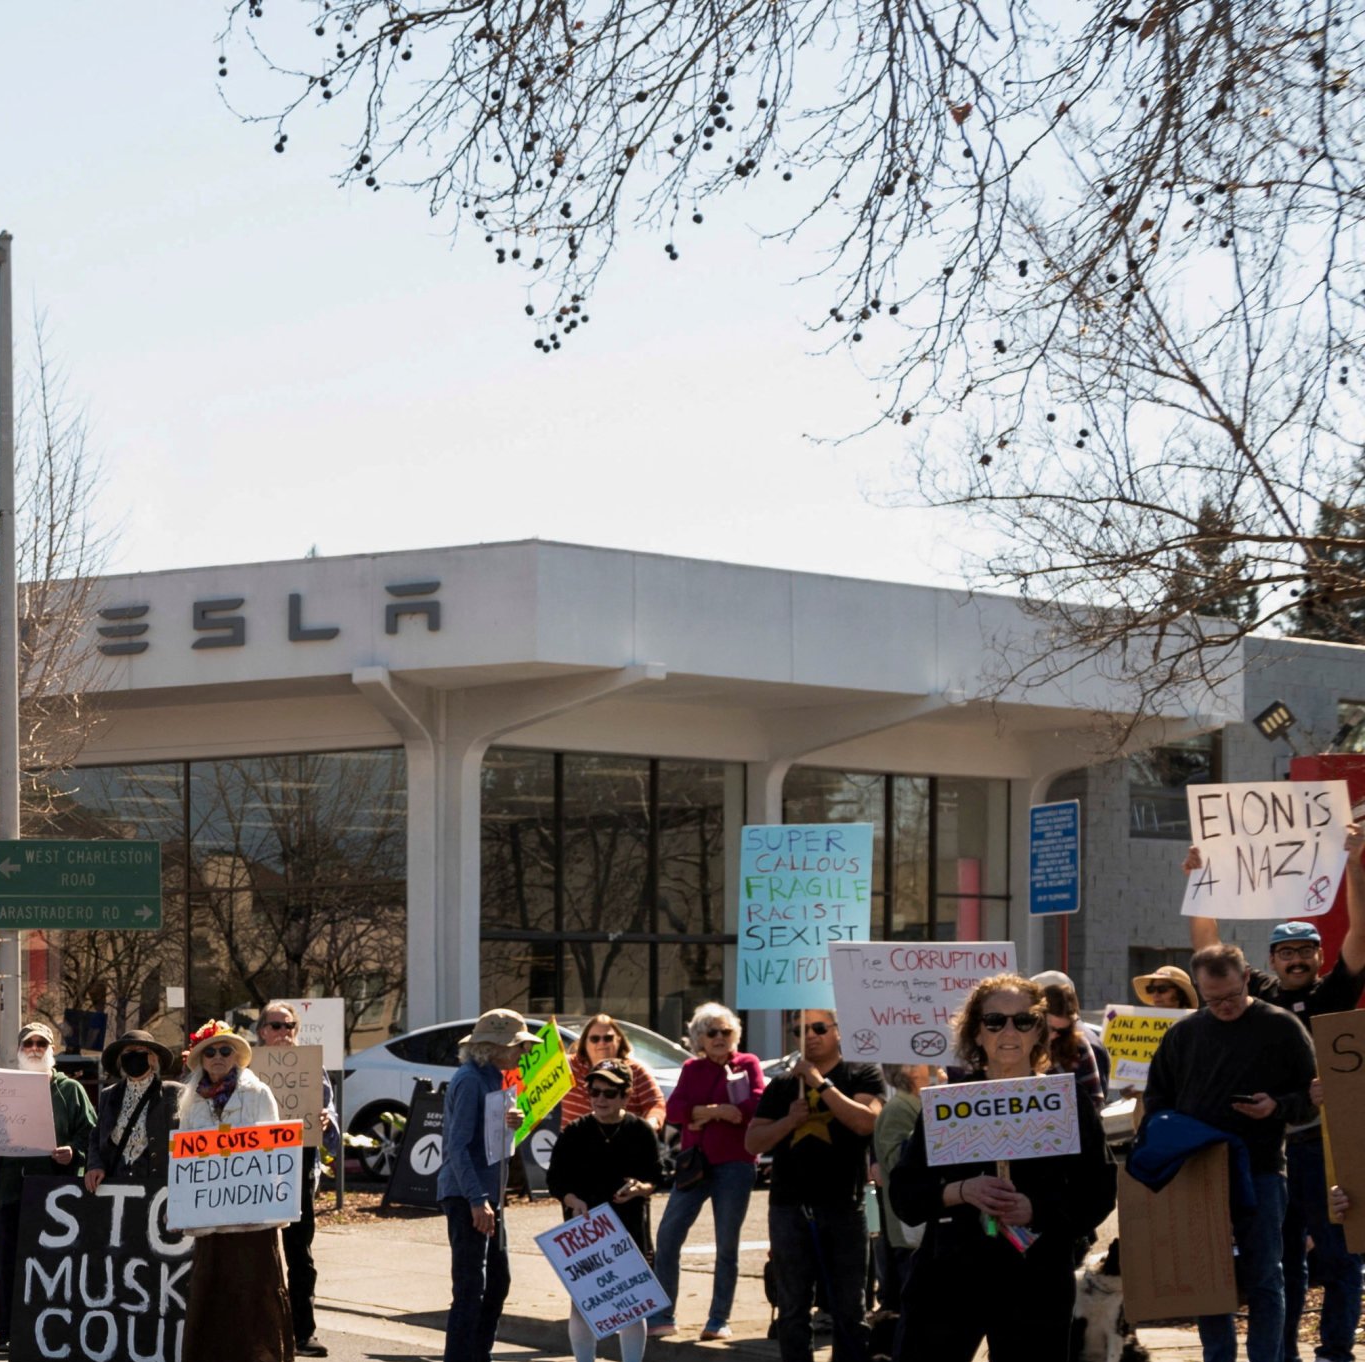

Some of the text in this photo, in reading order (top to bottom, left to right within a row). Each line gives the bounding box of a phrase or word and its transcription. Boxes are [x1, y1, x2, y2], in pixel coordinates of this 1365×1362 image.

[95, 581, 441, 656] ESLA
[745, 828, 846, 853] SUPER
[25, 849, 153, 864] WEST CHARLESTON
[755, 853, 861, 874] CALLOUS
[61, 873, 96, 887] ROAD
[744, 875, 869, 904] FRAGILE
[1191, 857, 1221, 900] A
[0, 905, 119, 920] ARASTRADERO RD
[747, 903, 846, 923] RACIST
[742, 925, 859, 951] SEXIST
[835, 947, 1007, 972] The CORRUPTION
[872, 978, 910, 994] coming
[908, 992, 934, 1004] the
[870, 1006, 925, 1026] White
[1112, 1019, 1134, 1029] LIKE
[1140, 1020, 1149, 1029] A
[299, 1024, 325, 1033] NTRY
[300, 1037, 322, 1045] NLY
[268, 1051, 299, 1067] NO
[259, 1071, 310, 1089] DOGE
[520, 1060, 565, 1116] LIGARCHY
[275, 1094, 299, 1110] NO
[935, 1093, 1062, 1122] DOGEBAG
[180, 1128, 295, 1156] NO CUTS TO
[175, 1153, 294, 1184] MEDICAID
[194, 1181, 291, 1209] FUNDING
[38, 1184, 195, 1257] STO
[552, 1213, 617, 1258] TREASON
[611, 1236, 634, 1258] 2021
[24, 1253, 193, 1317] MUSK
[596, 1270, 620, 1288] OUR
[581, 1269, 653, 1312] GRANDCHILDREN
[612, 1293, 640, 1311] WILL
[594, 1298, 658, 1333] REMEMBER
